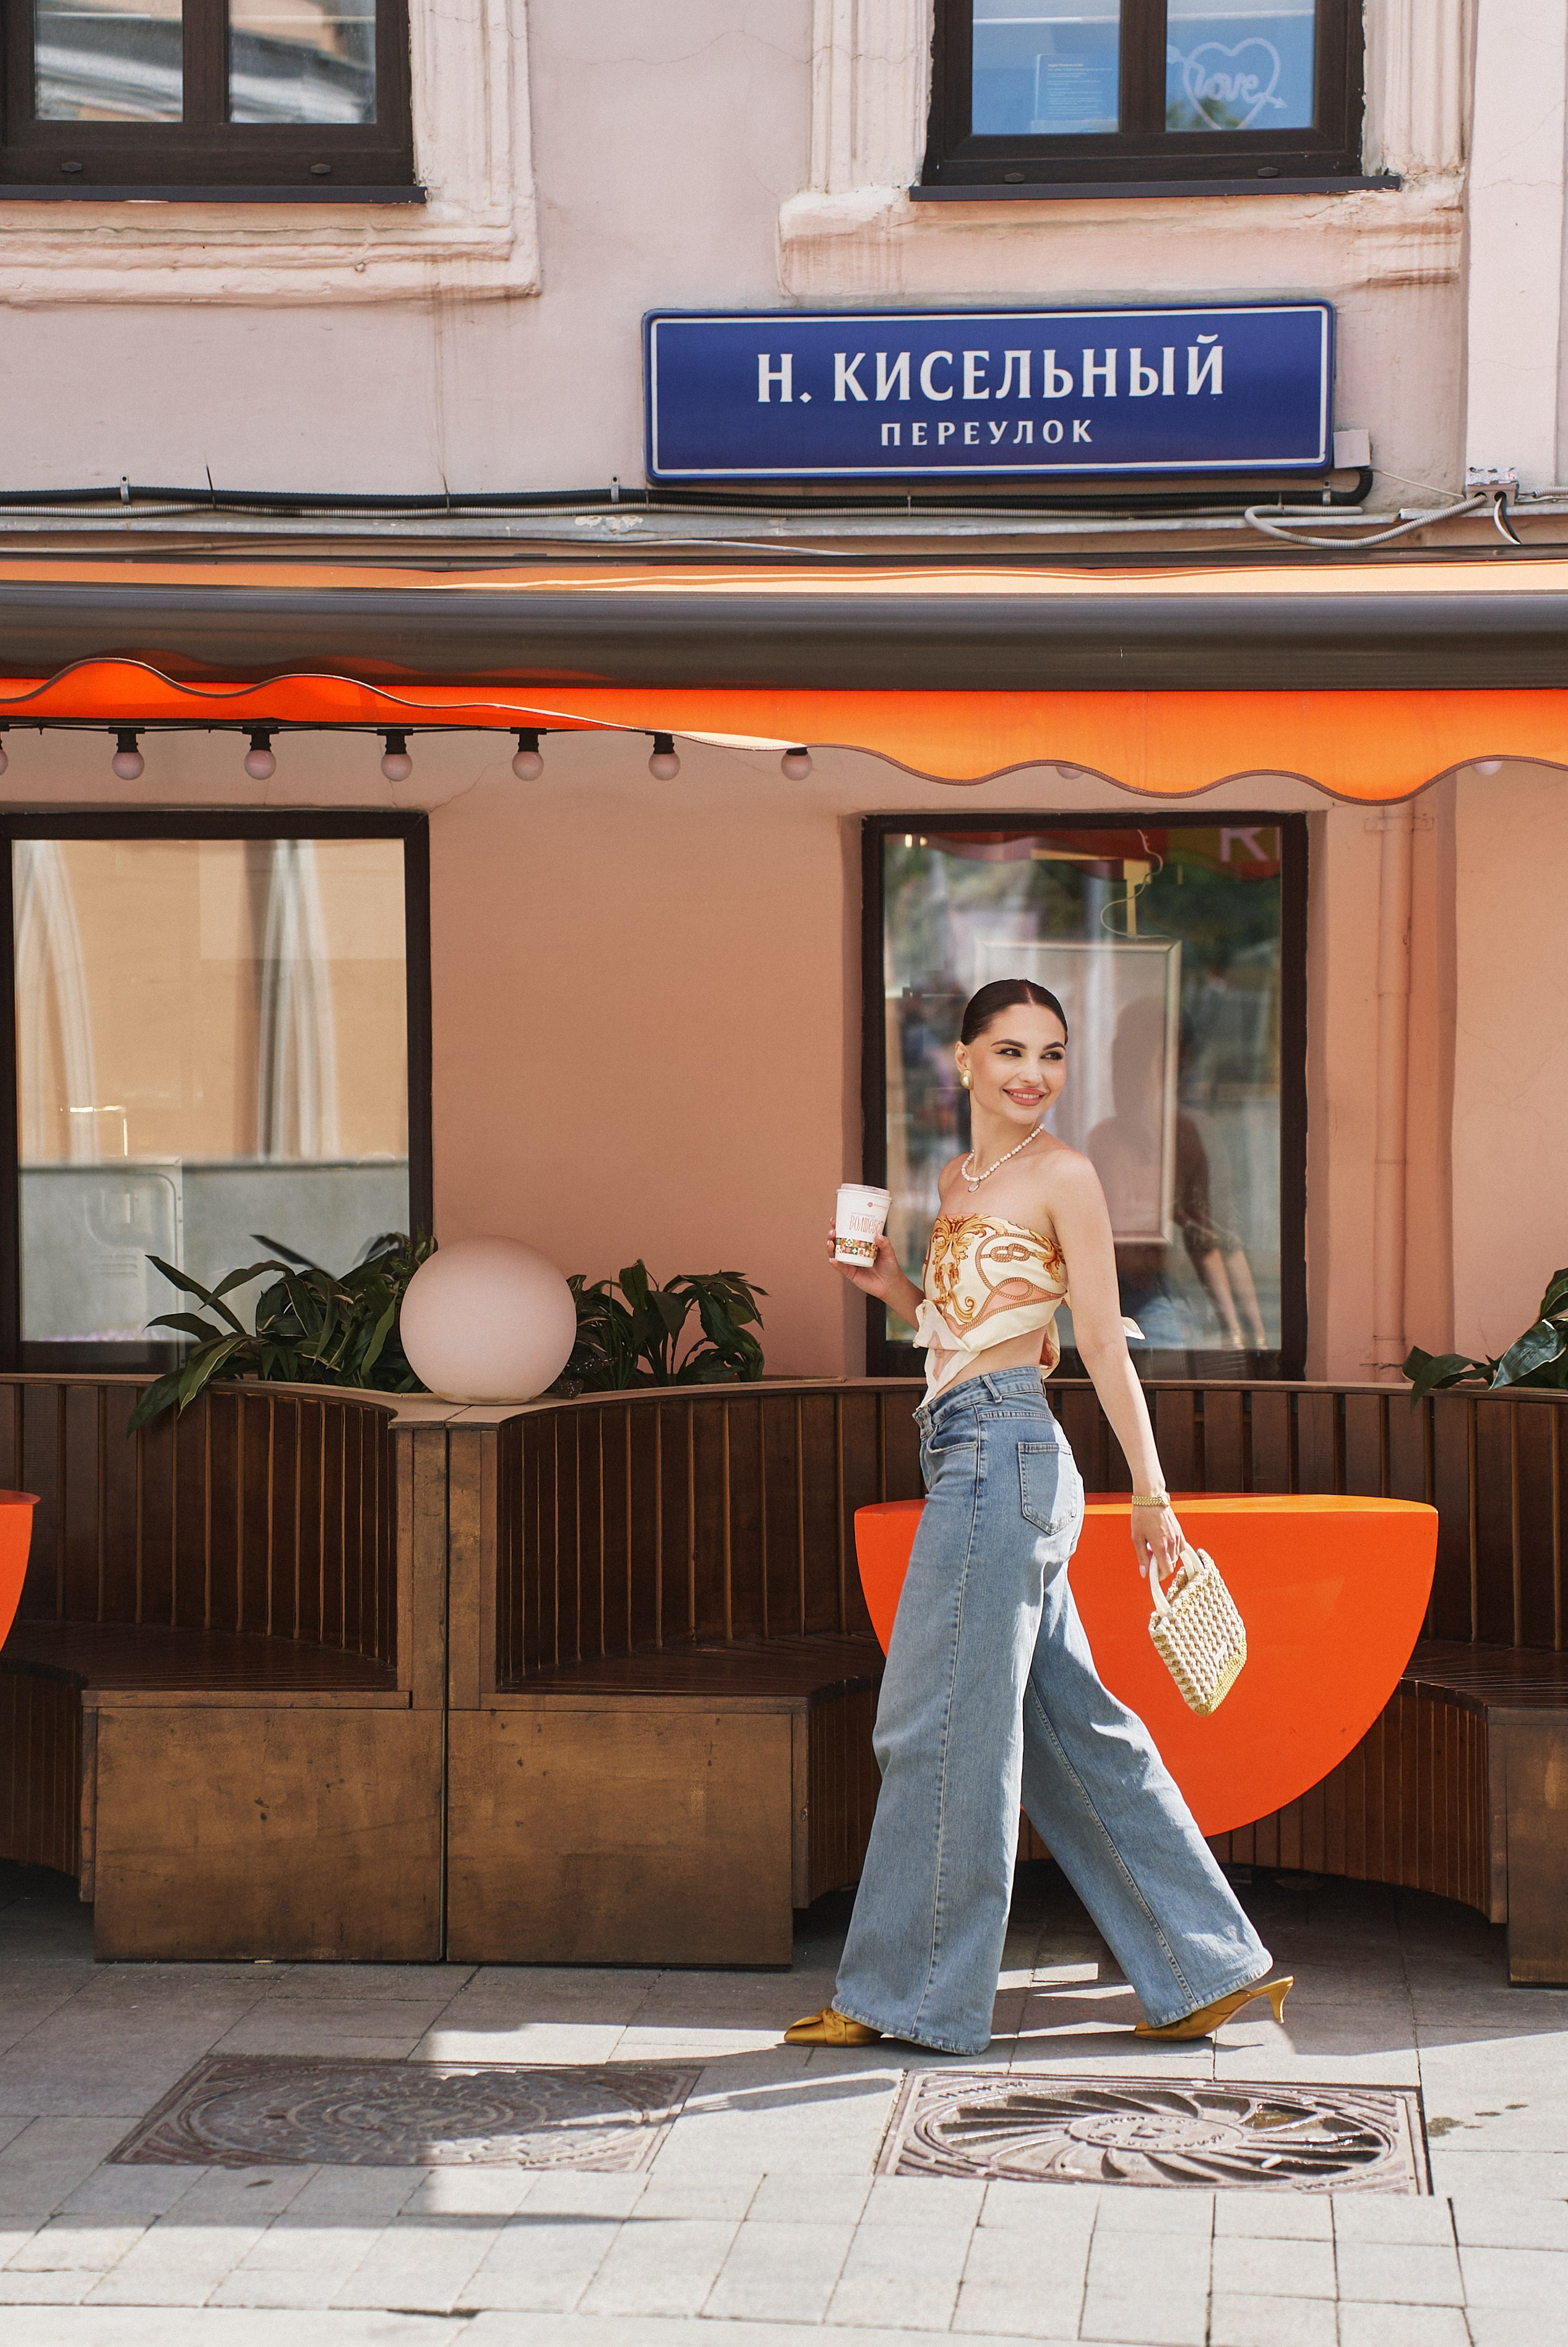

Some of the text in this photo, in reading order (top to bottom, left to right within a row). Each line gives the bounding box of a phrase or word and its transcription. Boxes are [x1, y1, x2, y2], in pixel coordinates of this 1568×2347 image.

[757, 334, 1223, 403] Н. КИСЕЛЬНЫЙ
[881, 420, 1092, 446] ПЕРЕУЛОК
